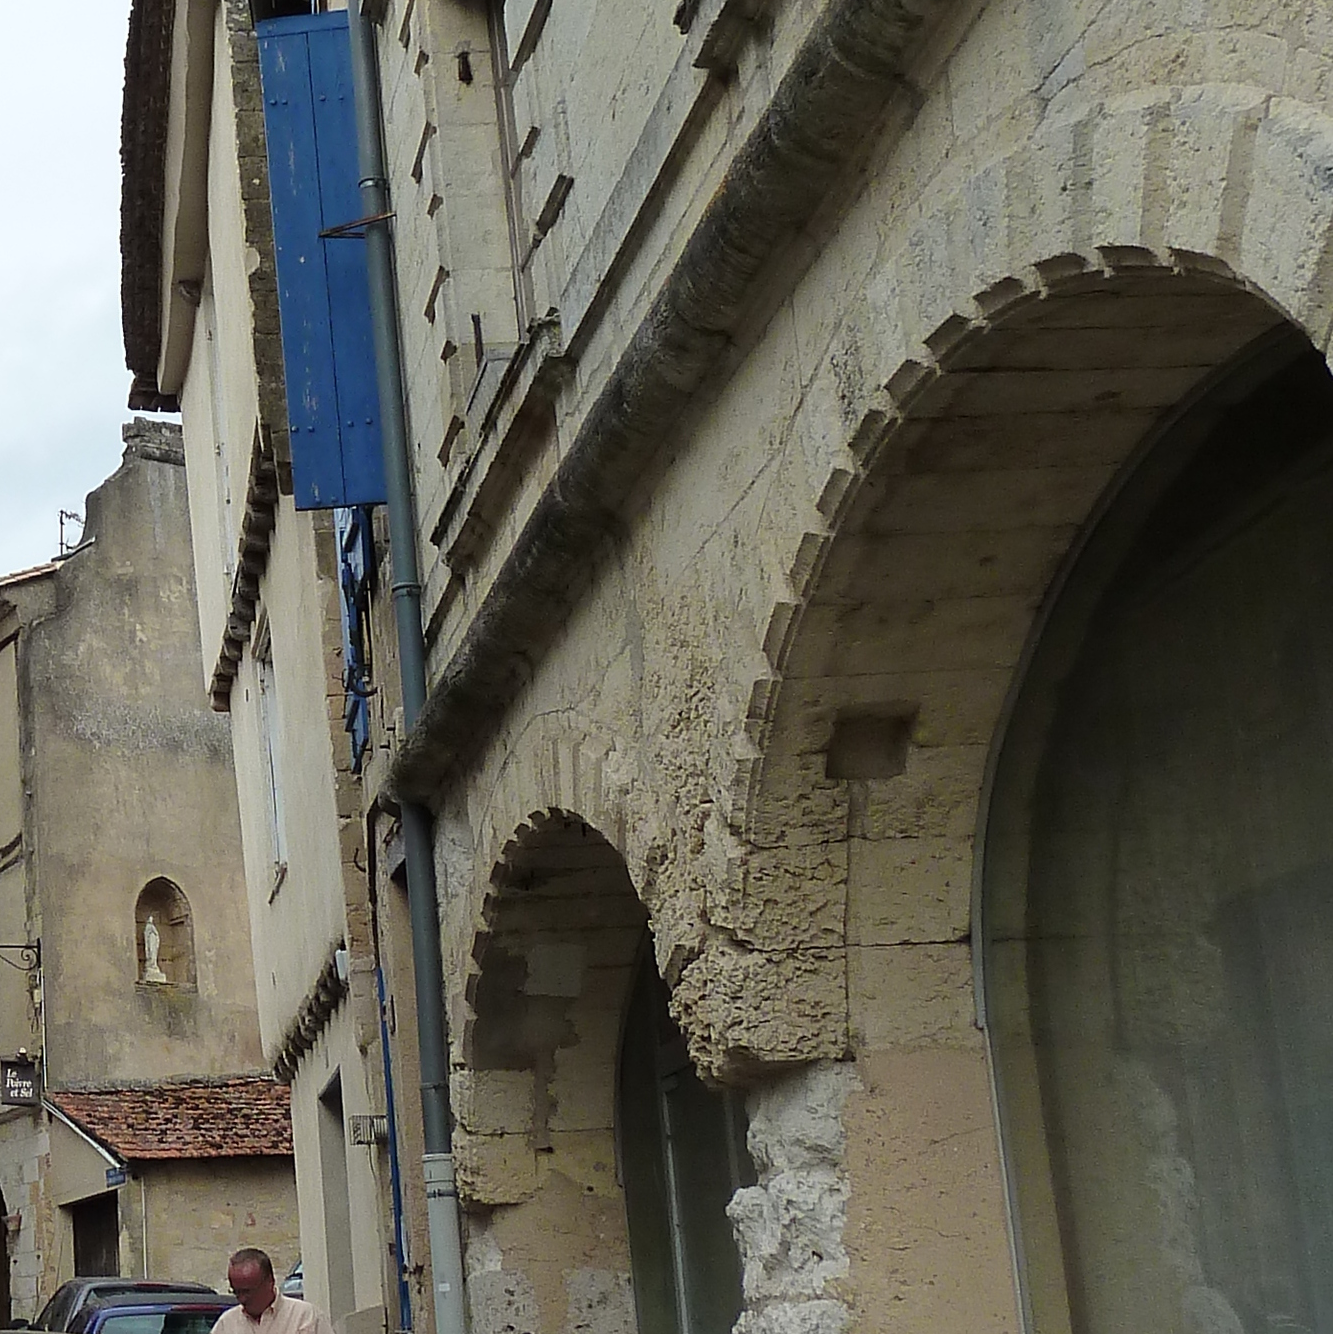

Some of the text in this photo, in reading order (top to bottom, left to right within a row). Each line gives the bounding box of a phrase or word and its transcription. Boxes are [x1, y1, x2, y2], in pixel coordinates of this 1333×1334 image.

[7, 1068, 17, 1078] Le
[10, 1087, 33, 1098] et Sel
